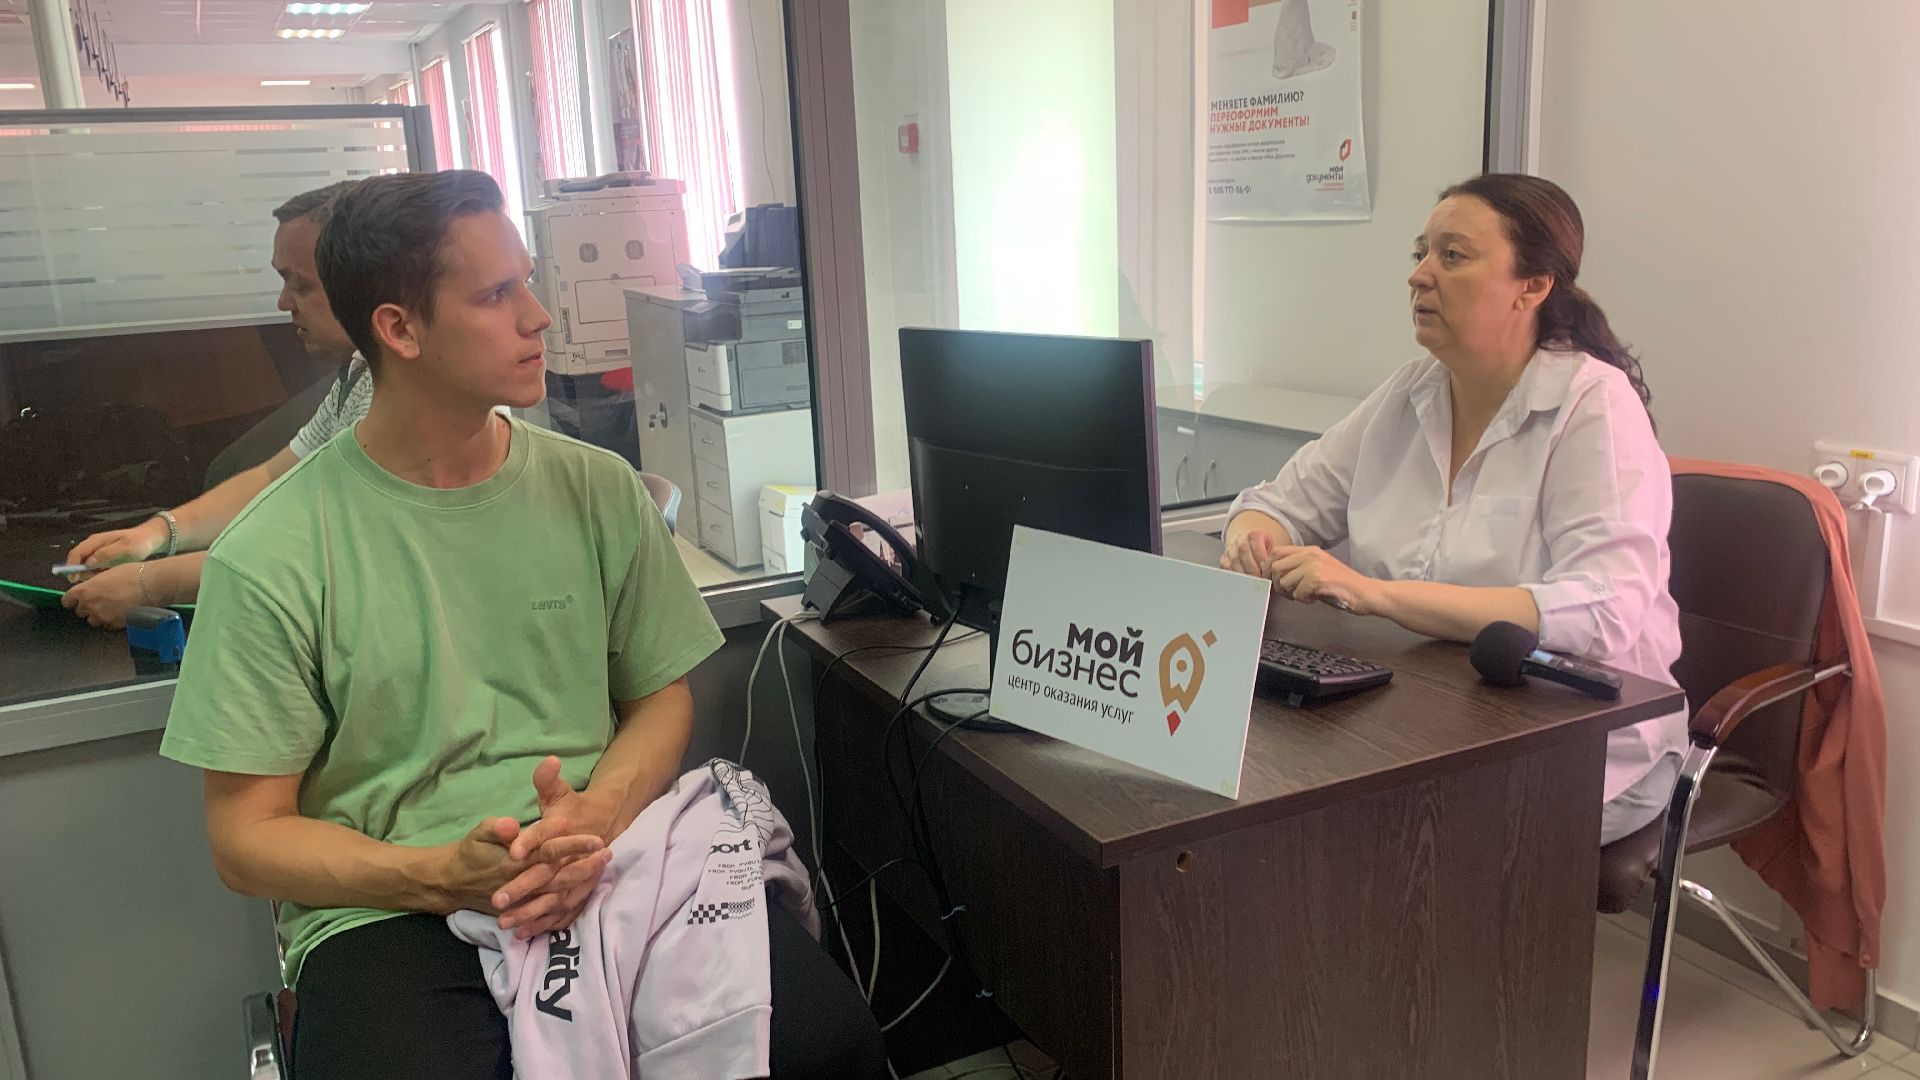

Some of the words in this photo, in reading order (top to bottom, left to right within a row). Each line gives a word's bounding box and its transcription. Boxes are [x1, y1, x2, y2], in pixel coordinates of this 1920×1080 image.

[1210, 97, 1248, 111] МЕНЯЕТЕ
[1249, 91, 1304, 107] ФАМИЛИЮ?
[1210, 106, 1278, 122] ПЕРЕОФОРМИМ
[1209, 120, 1247, 134] НУЖНЫЕ
[1248, 115, 1310, 132] ДОКУМЕНТЫ!
[1066, 622, 1144, 668] мой
[1012, 629, 1141, 698] бизнес
[1008, 674, 1041, 696] центр
[1043, 685, 1098, 713] оказания
[1101, 702, 1135, 725] услуг
